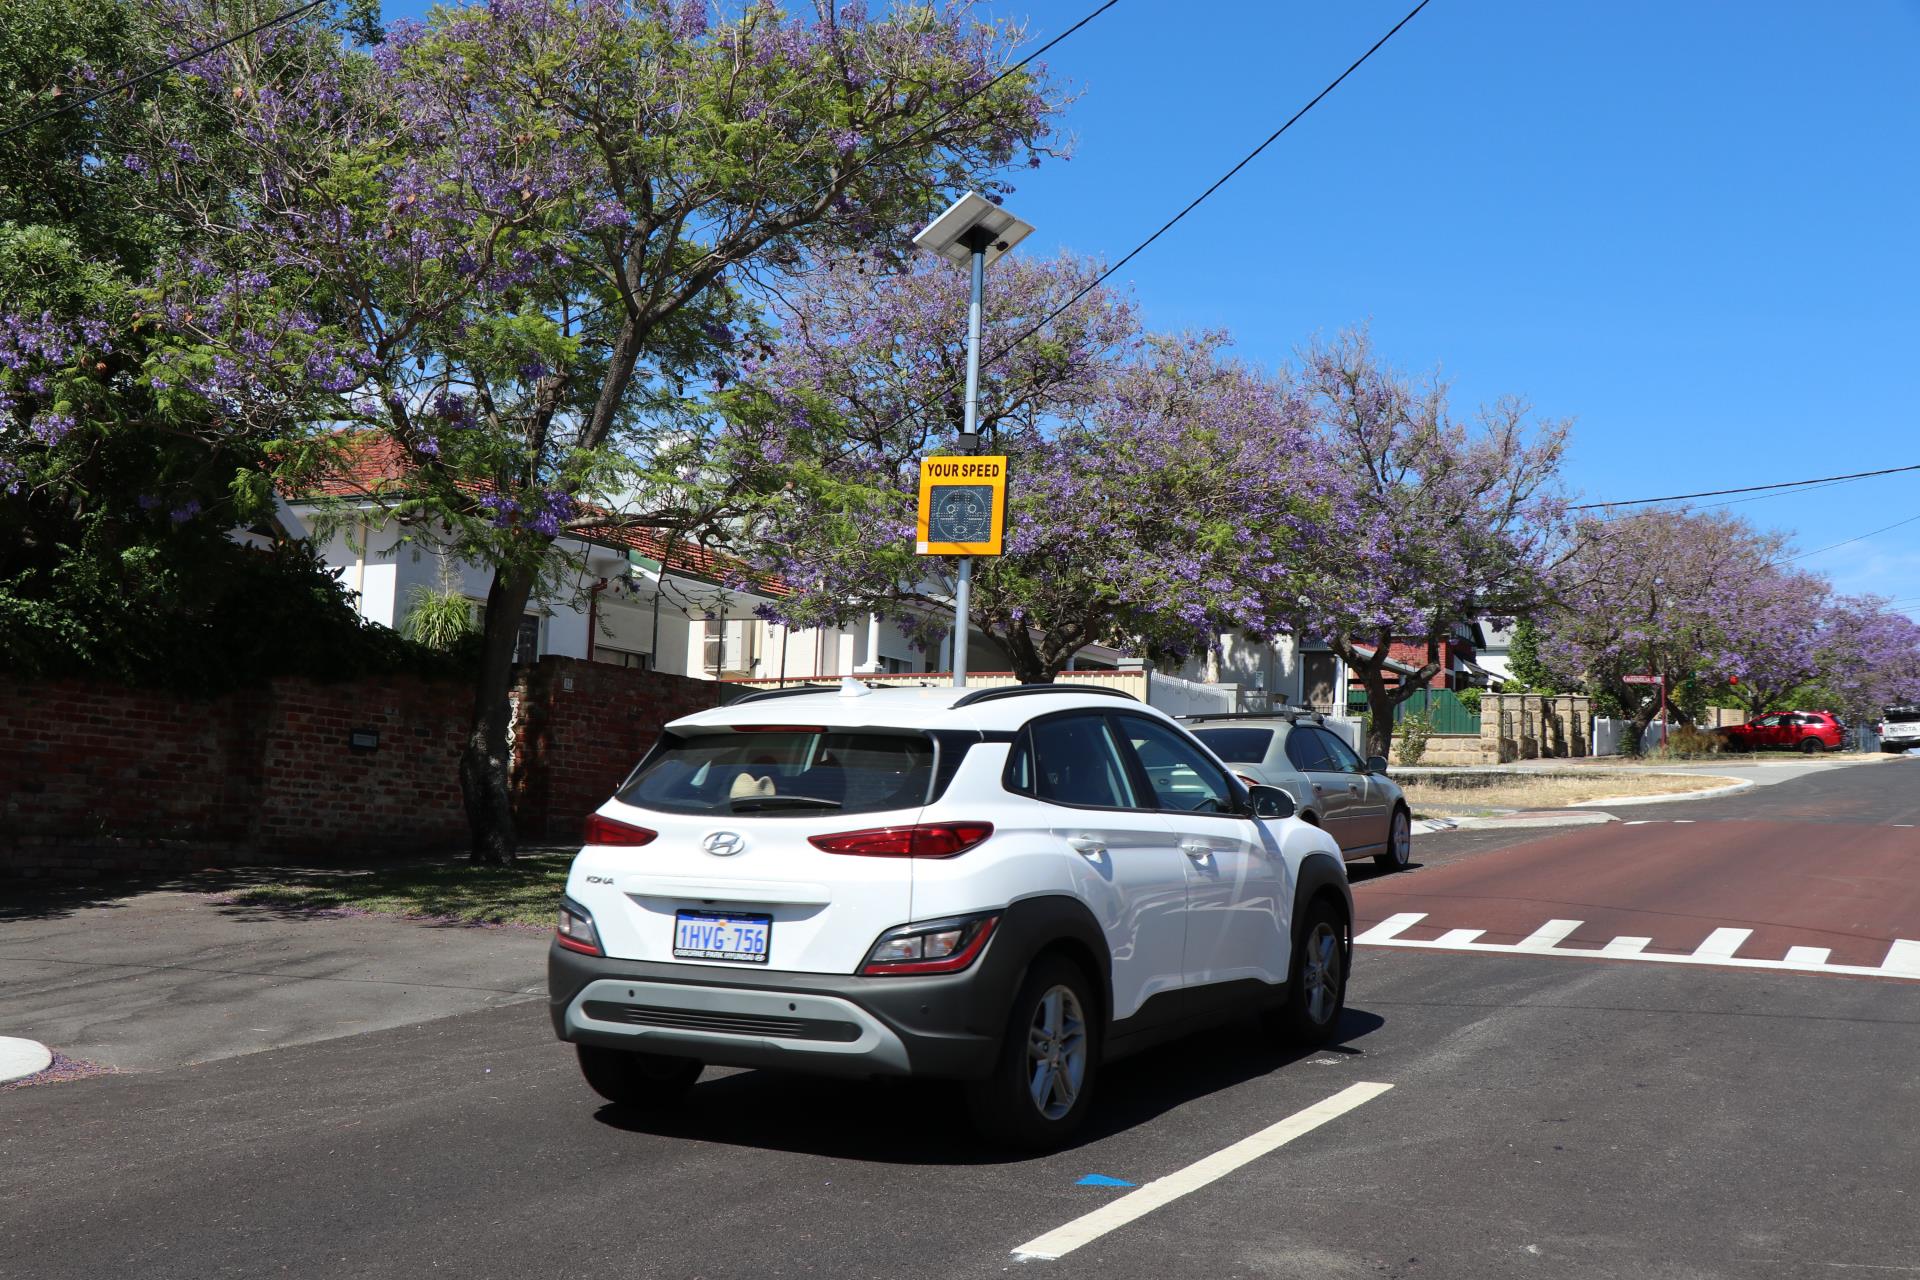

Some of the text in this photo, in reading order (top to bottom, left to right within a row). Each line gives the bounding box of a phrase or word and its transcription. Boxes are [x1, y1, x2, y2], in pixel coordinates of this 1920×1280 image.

[928, 464, 999, 477] YOUR SPEED
[586, 875, 615, 885] KONA
[706, 951, 723, 959] PARK
